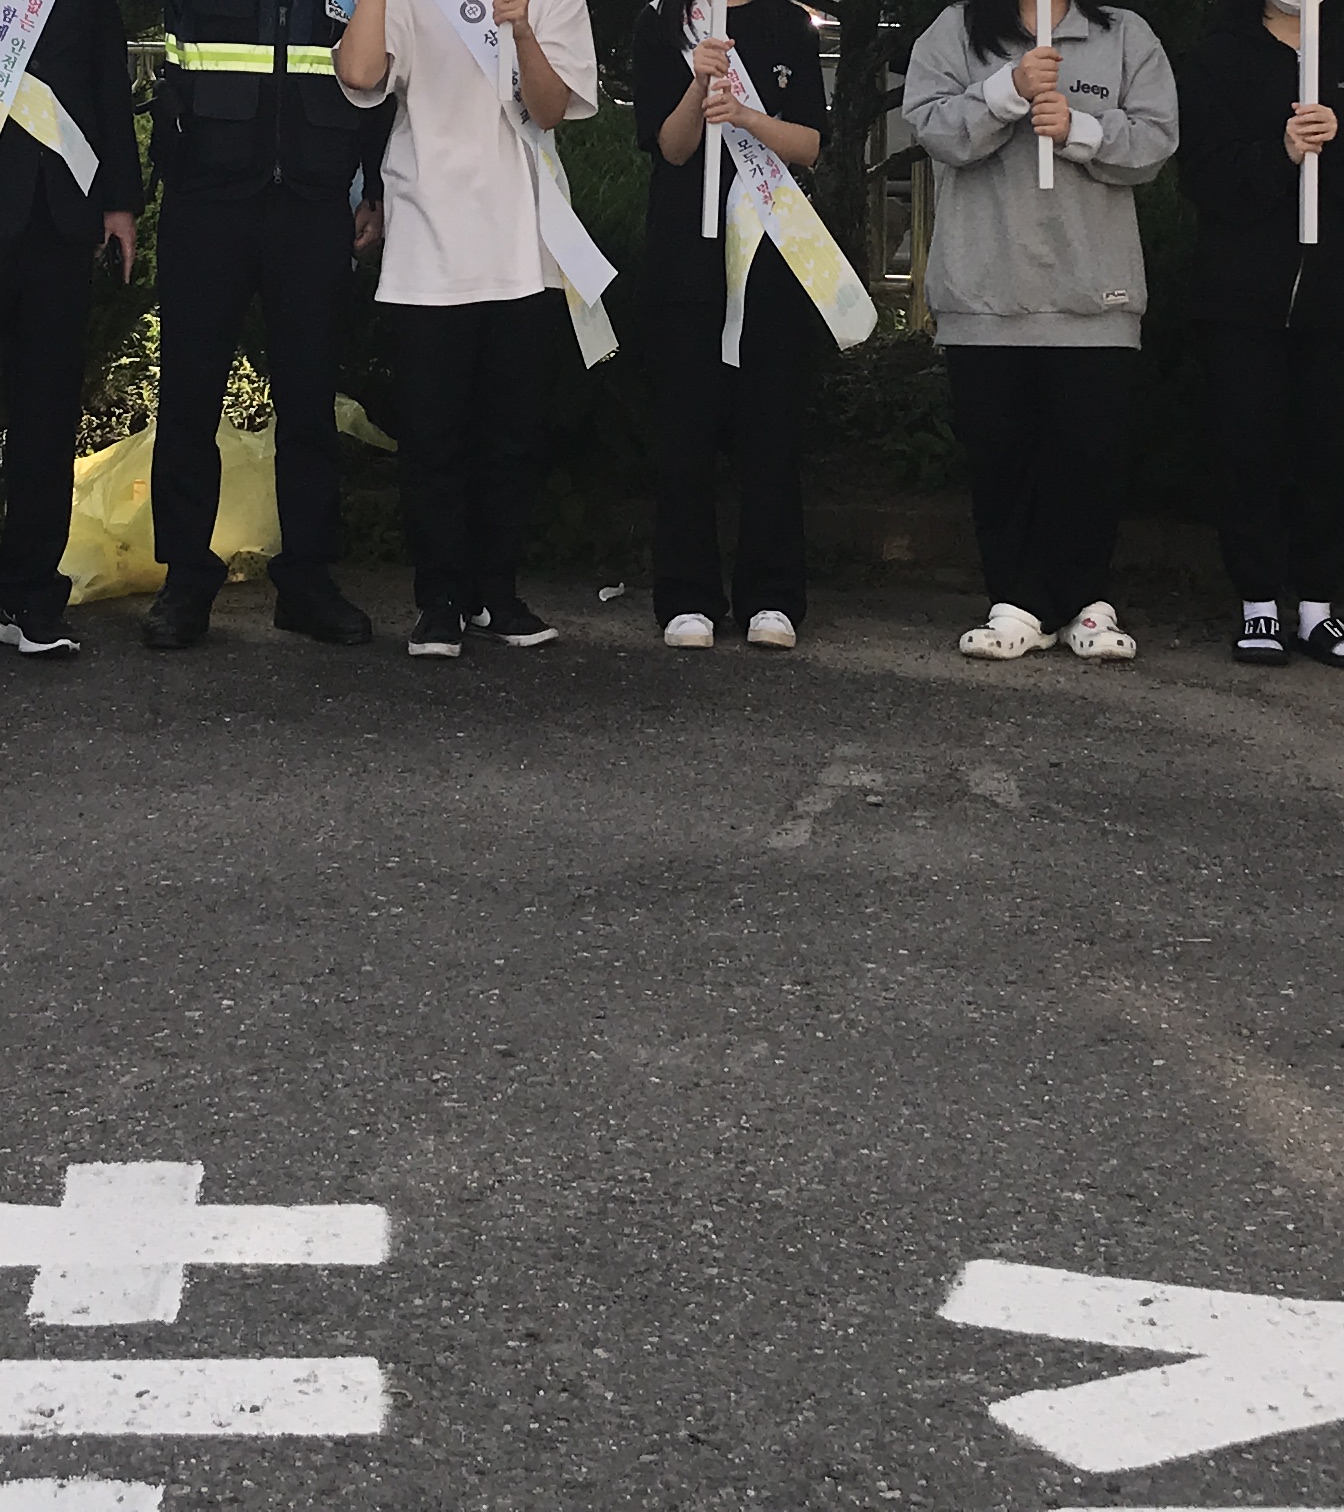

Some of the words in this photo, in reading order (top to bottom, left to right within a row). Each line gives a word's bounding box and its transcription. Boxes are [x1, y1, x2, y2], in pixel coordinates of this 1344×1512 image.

[1069, 79, 1110, 99] Jeep
[737, 139, 765, 179] 모두가
[1244, 618, 1280, 635] GAP
